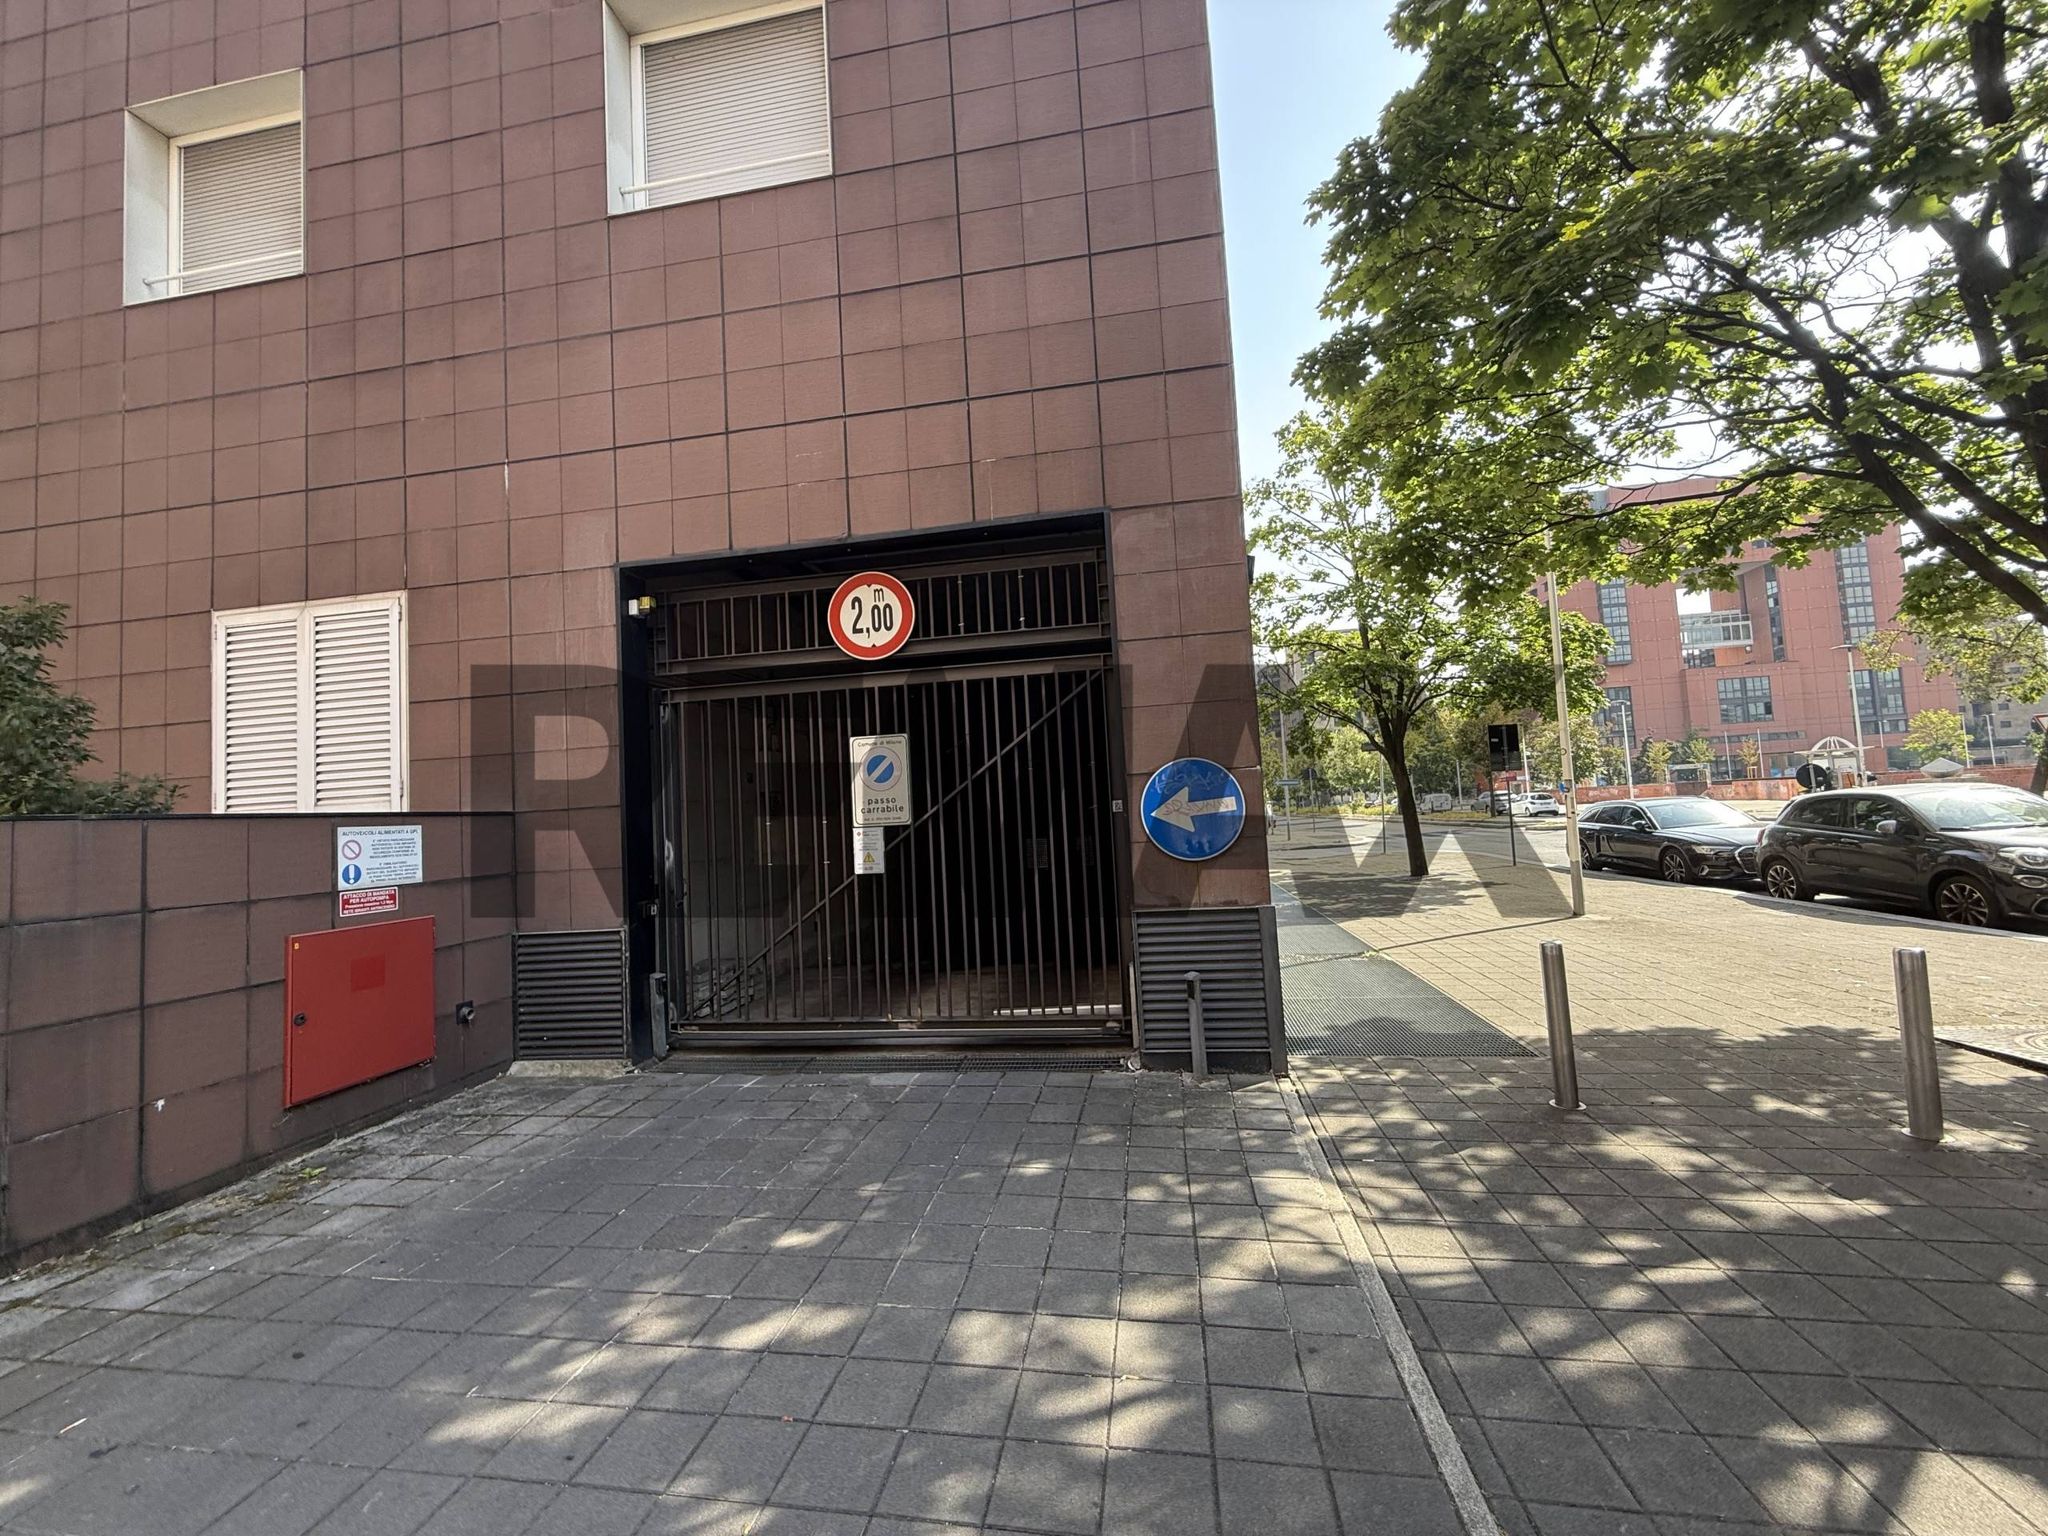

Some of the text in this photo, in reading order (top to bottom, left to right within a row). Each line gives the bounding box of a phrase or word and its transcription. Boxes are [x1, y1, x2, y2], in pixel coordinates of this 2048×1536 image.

[873, 588, 884, 602] m
[851, 596, 893, 638] 2,00
[867, 798, 896, 806] passo
[860, 805, 905, 814] carrabile
